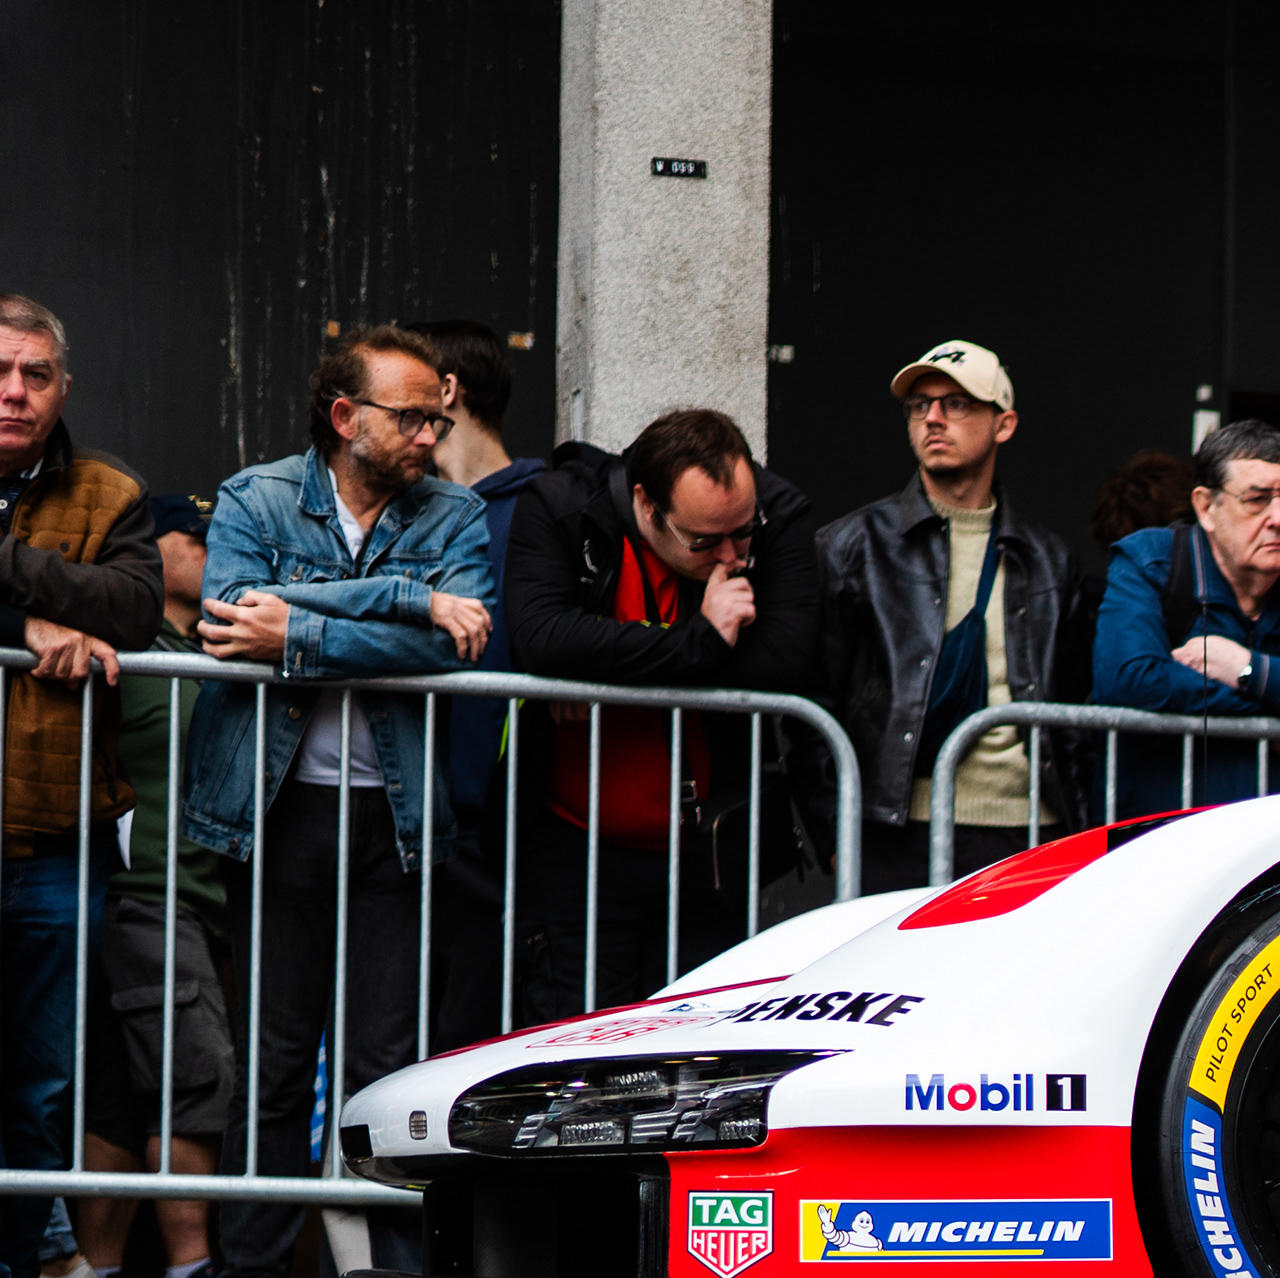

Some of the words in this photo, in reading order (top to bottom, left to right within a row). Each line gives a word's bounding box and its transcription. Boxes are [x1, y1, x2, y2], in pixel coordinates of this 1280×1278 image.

[1205, 1023, 1234, 1083] PILOT
[1230, 963, 1273, 1024] SPORT
[905, 1073, 1035, 1112] Mobil
[694, 1199, 765, 1225] TAG
[887, 1220, 1085, 1244] MICHELIN
[692, 1231, 766, 1274] HEUER
